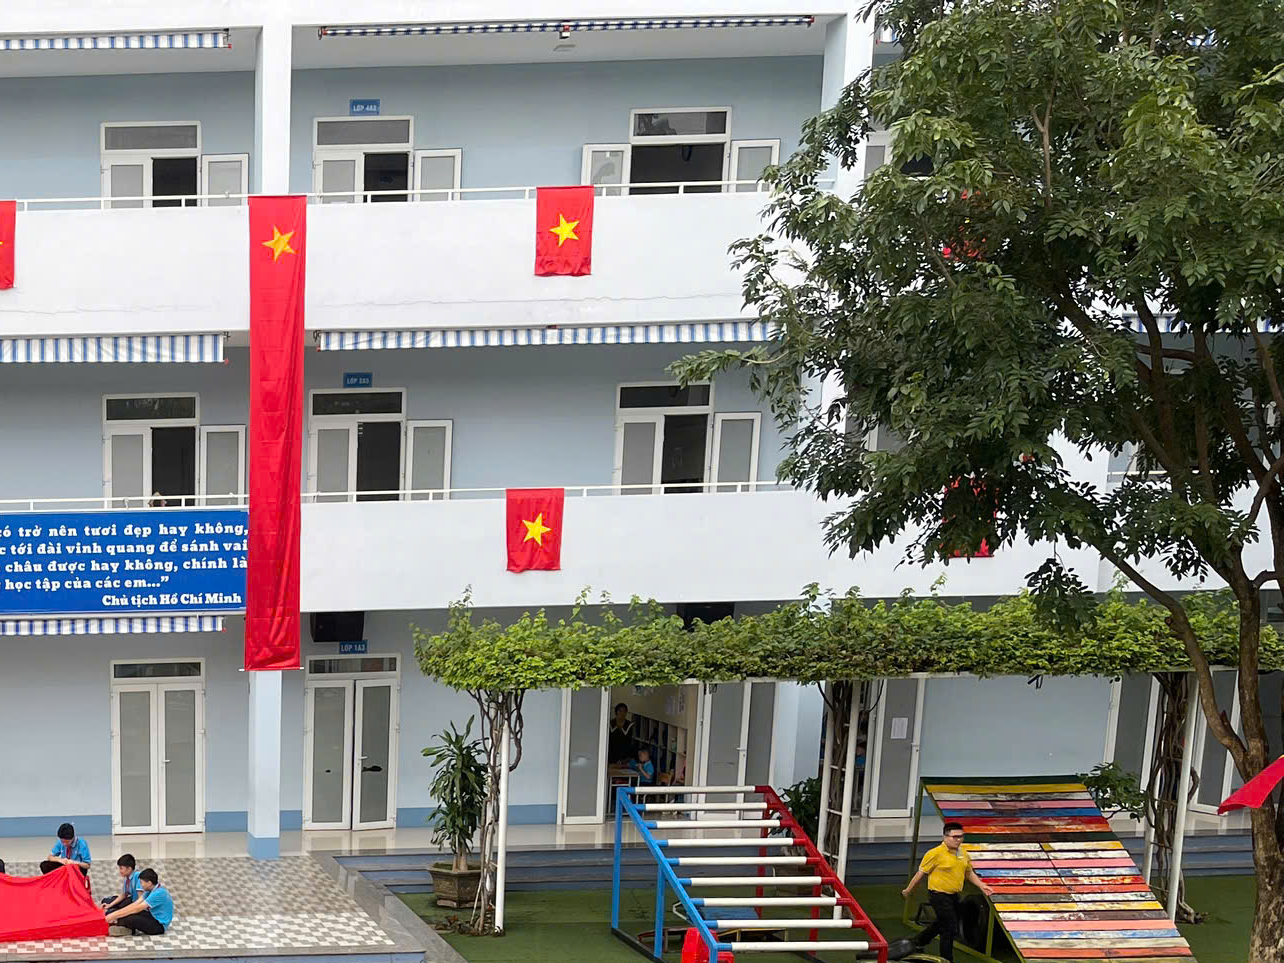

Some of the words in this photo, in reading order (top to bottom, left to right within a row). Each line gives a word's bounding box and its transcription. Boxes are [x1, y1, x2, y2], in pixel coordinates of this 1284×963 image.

[18, 525, 41, 536] trở
[49, 525, 77, 536] nên
[84, 524, 116, 536] tươi
[124, 525, 151, 537] đẹp
[159, 524, 188, 536] hay
[11, 543, 32, 554] tới
[37, 542, 61, 554] đài
[66, 543, 102, 553] vinh
[106, 545, 154, 555] quang
[160, 539, 177, 552] để
[182, 540, 219, 551] sánh
[223, 539, 248, 551] vai
[5, 561, 42, 572] châu
[48, 561, 85, 573] được
[91, 560, 119, 572] hay
[183, 557, 227, 569] chính
[233, 556, 248, 569] là
[5, 579, 31, 592] học
[36, 578, 60, 591] tập
[65, 577, 91, 588] của
[96, 576, 120, 588] các
[102, 595, 128, 605] Chủ
[131, 595, 157, 607] tịch
[180, 593, 202, 604] Chí
[205, 593, 241, 603] Minh
